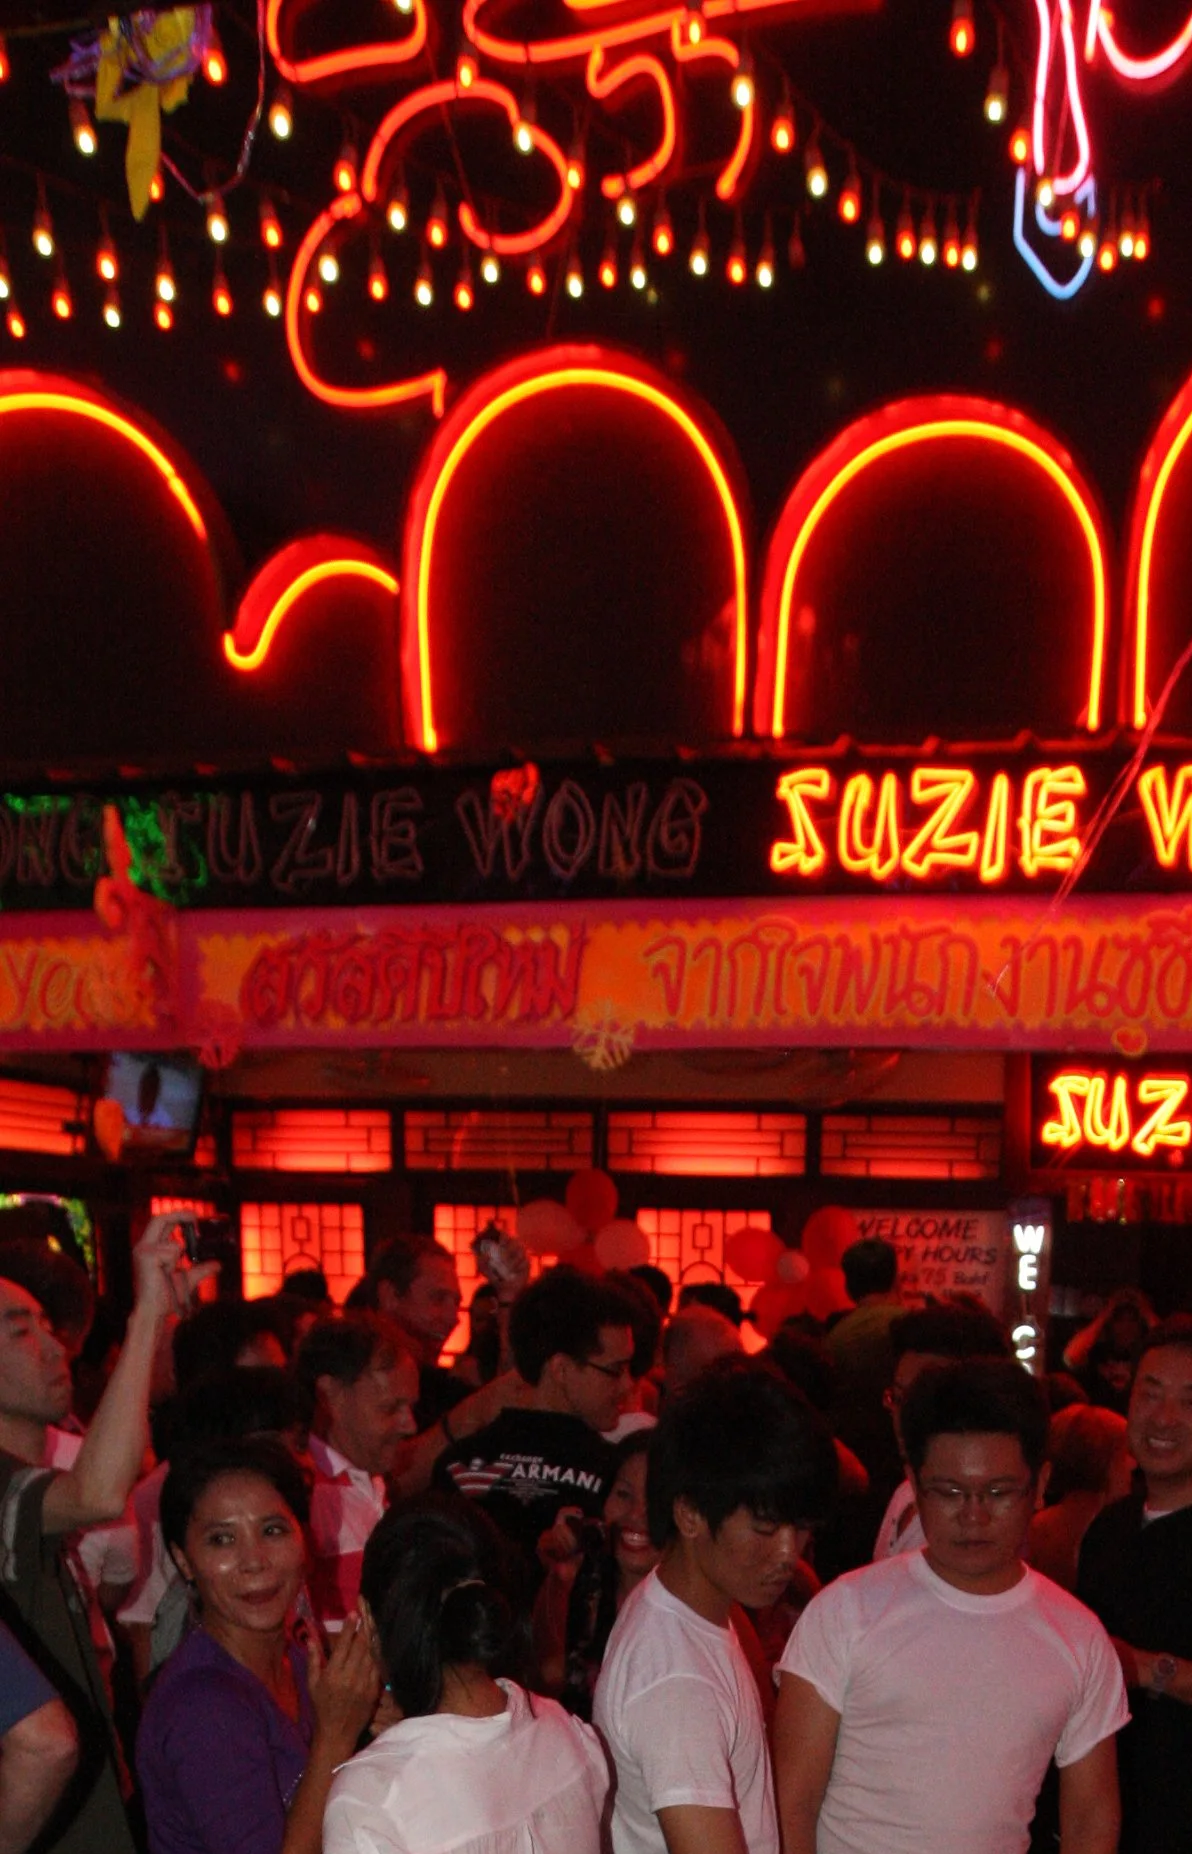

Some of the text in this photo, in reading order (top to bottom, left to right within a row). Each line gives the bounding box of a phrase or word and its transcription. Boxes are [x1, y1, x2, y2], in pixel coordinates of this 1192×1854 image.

[456, 778, 707, 882] WONG
[770, 766, 1085, 882] SUZIE
[921, 1245, 999, 1266] HOURS
[510, 1462, 603, 1495] ARMANI
